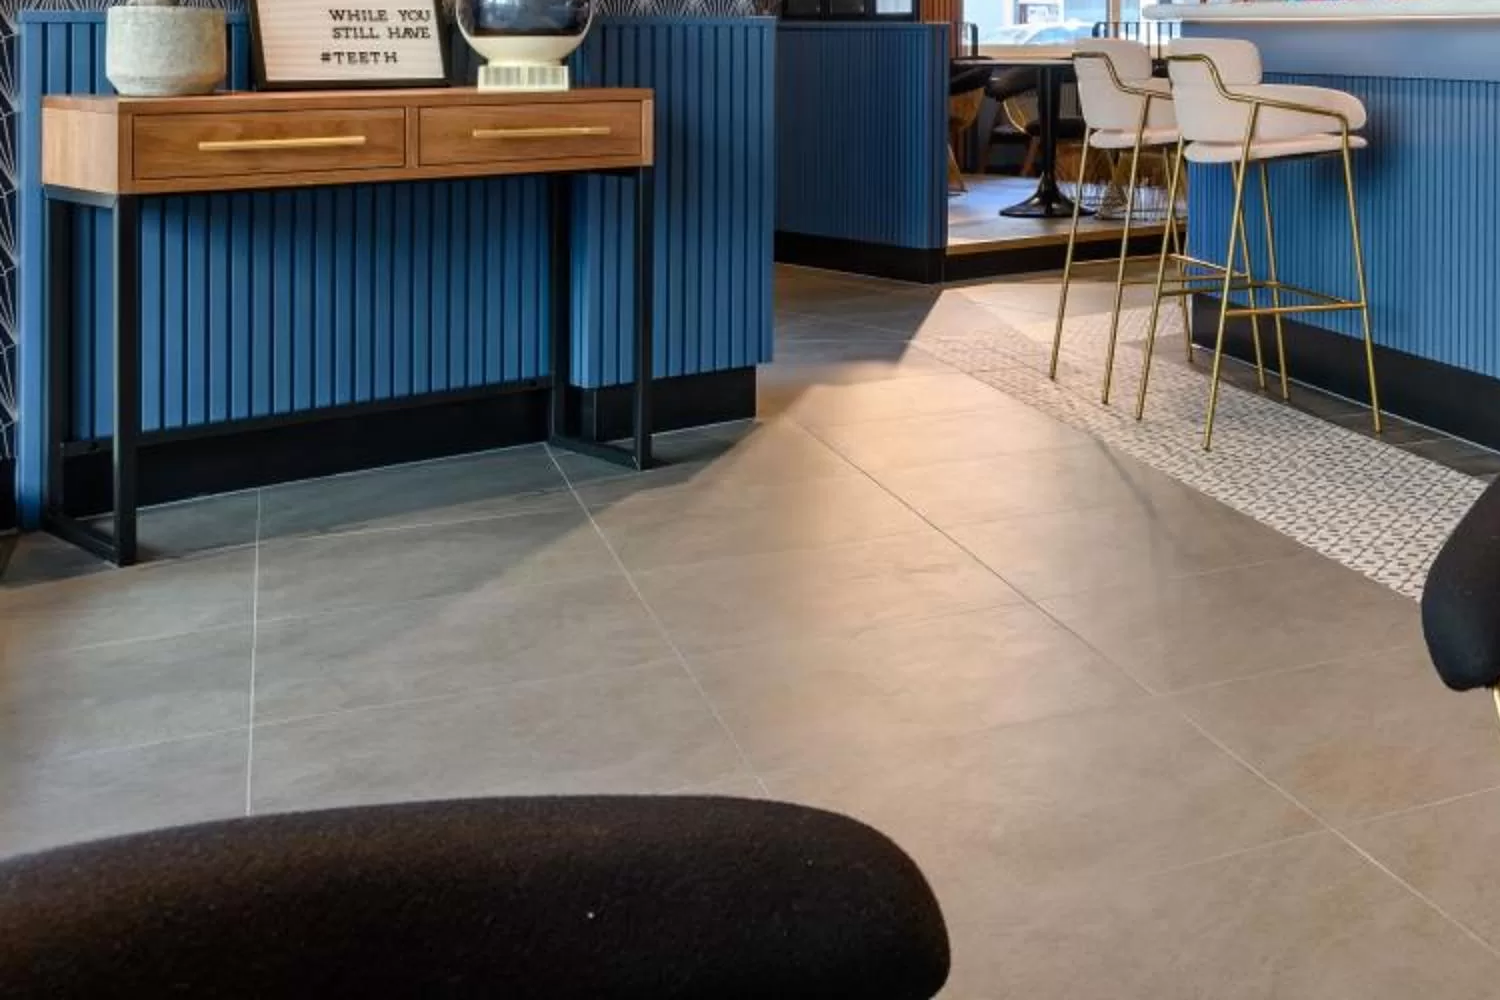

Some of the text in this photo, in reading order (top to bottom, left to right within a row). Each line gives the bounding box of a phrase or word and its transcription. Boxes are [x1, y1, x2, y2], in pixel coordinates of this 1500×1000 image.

[328, 9, 431, 22] WHILE YOU
[332, 26, 431, 40] STILL HAVE
[320, 51, 398, 65] #TEETH
